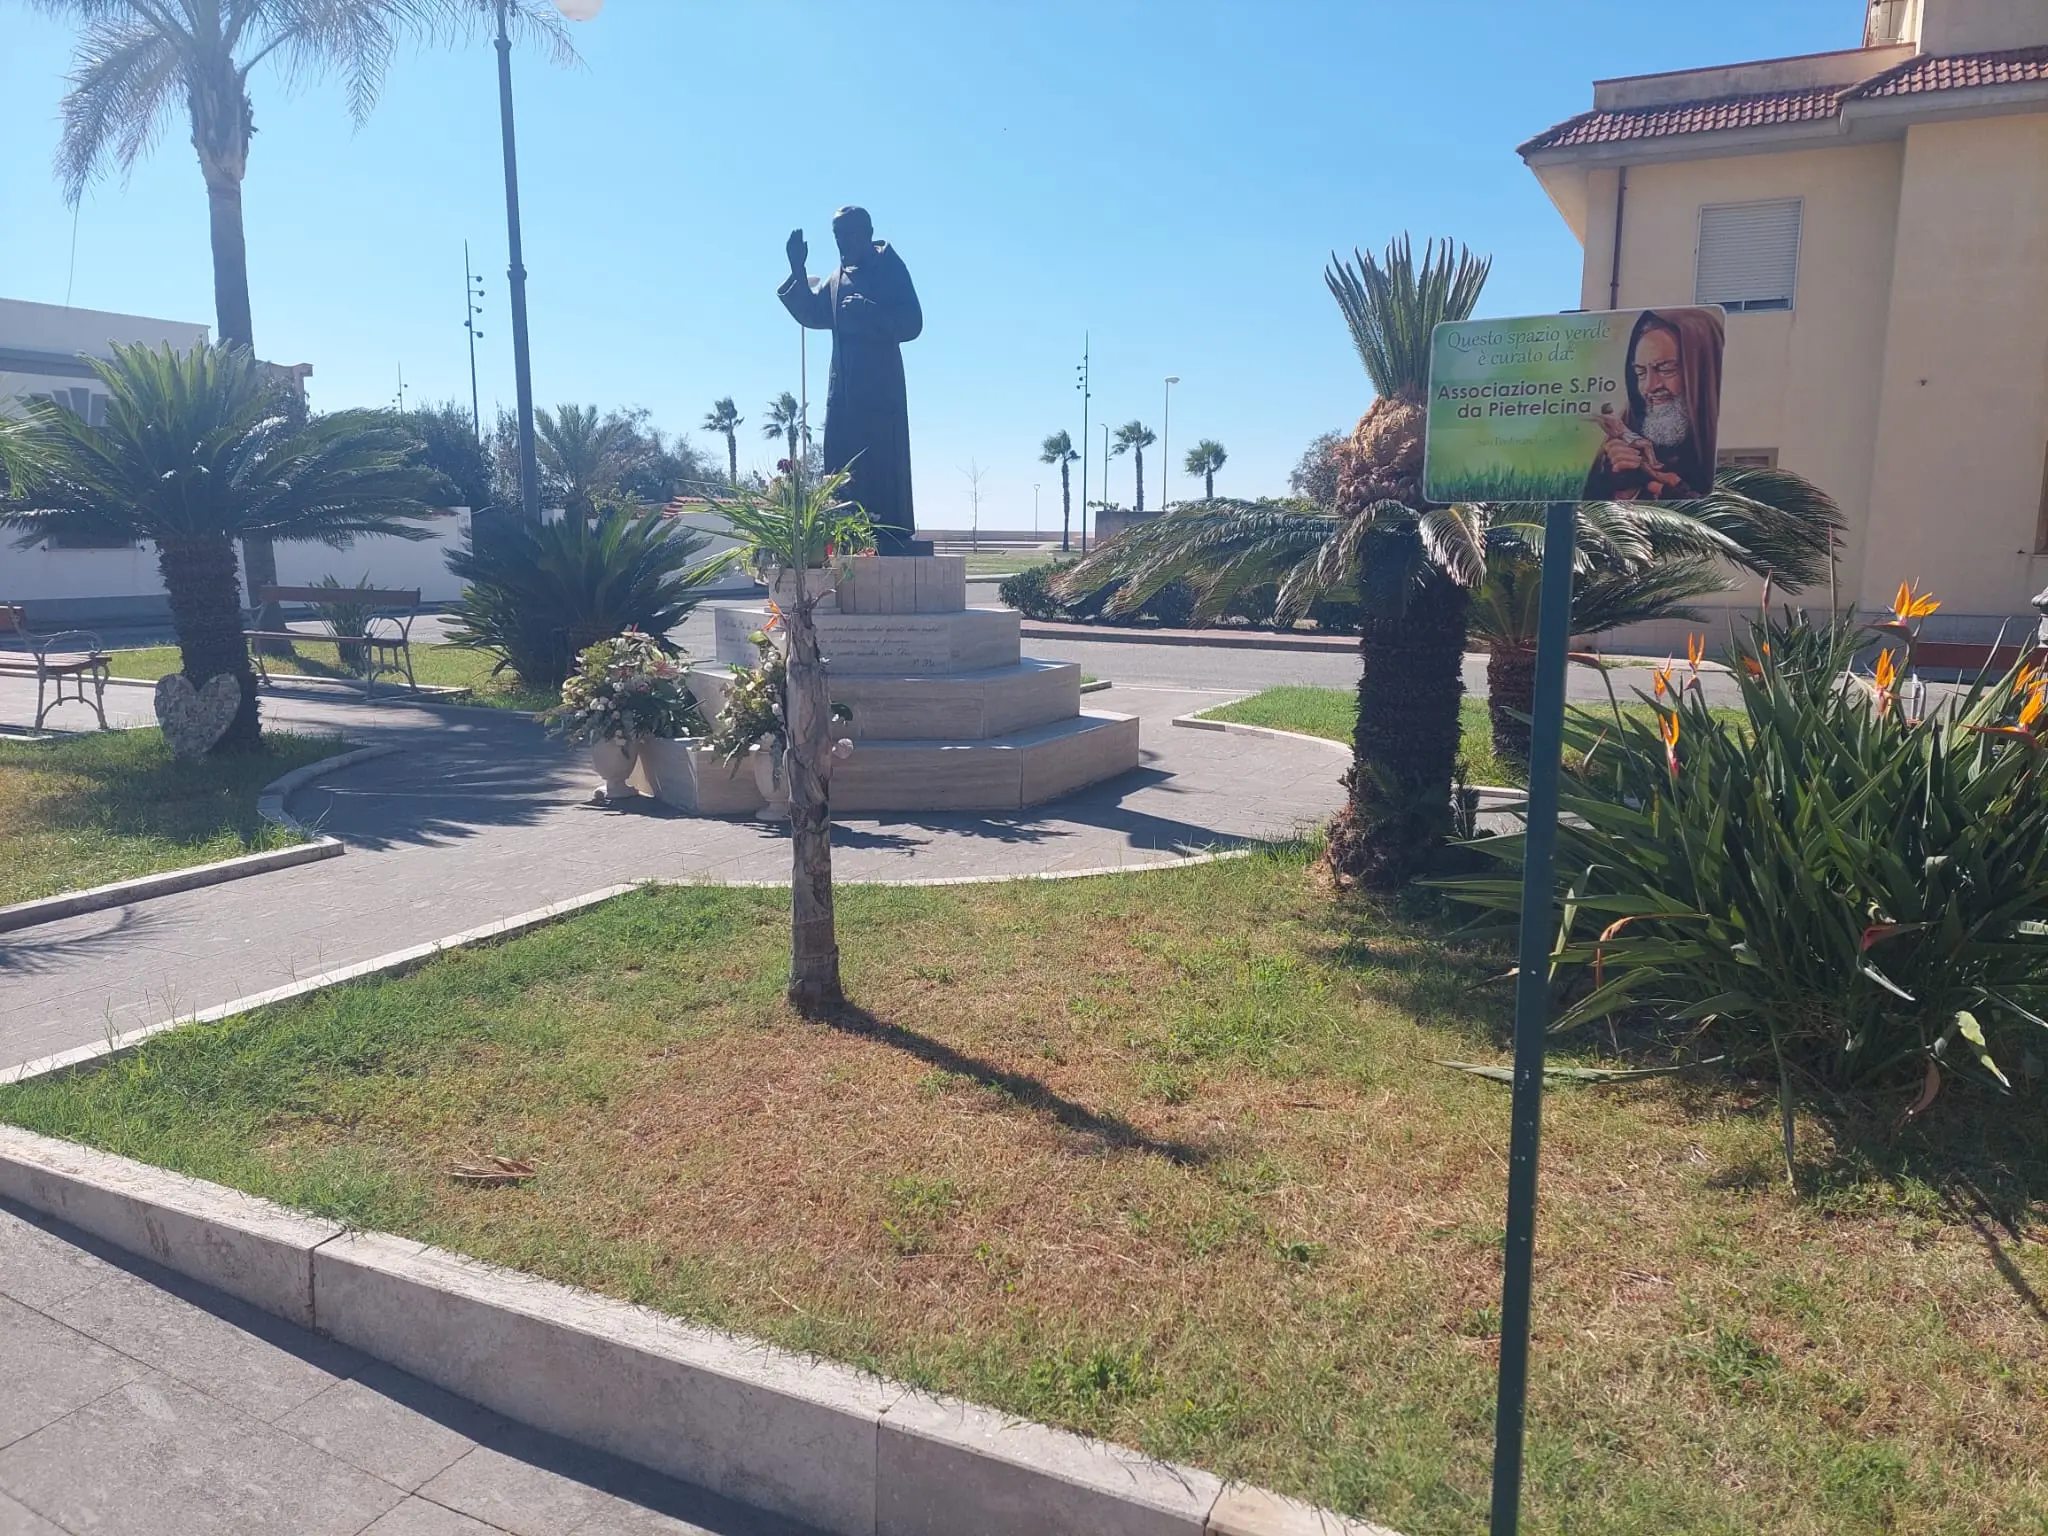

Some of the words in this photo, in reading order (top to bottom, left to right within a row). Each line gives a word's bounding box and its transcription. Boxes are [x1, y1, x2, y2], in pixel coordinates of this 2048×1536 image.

[1447, 330, 1503, 353] Questo
[1507, 324, 1559, 350] spazio
[1564, 320, 1610, 339] verde
[1478, 350, 1489, 366] è
[1491, 347, 1543, 365] curato
[1438, 381, 1562, 399] Associazione
[1570, 376, 1617, 394] S.Pio
[1457, 404, 1482, 419] da
[1489, 398, 1591, 416] Pietrelcina
